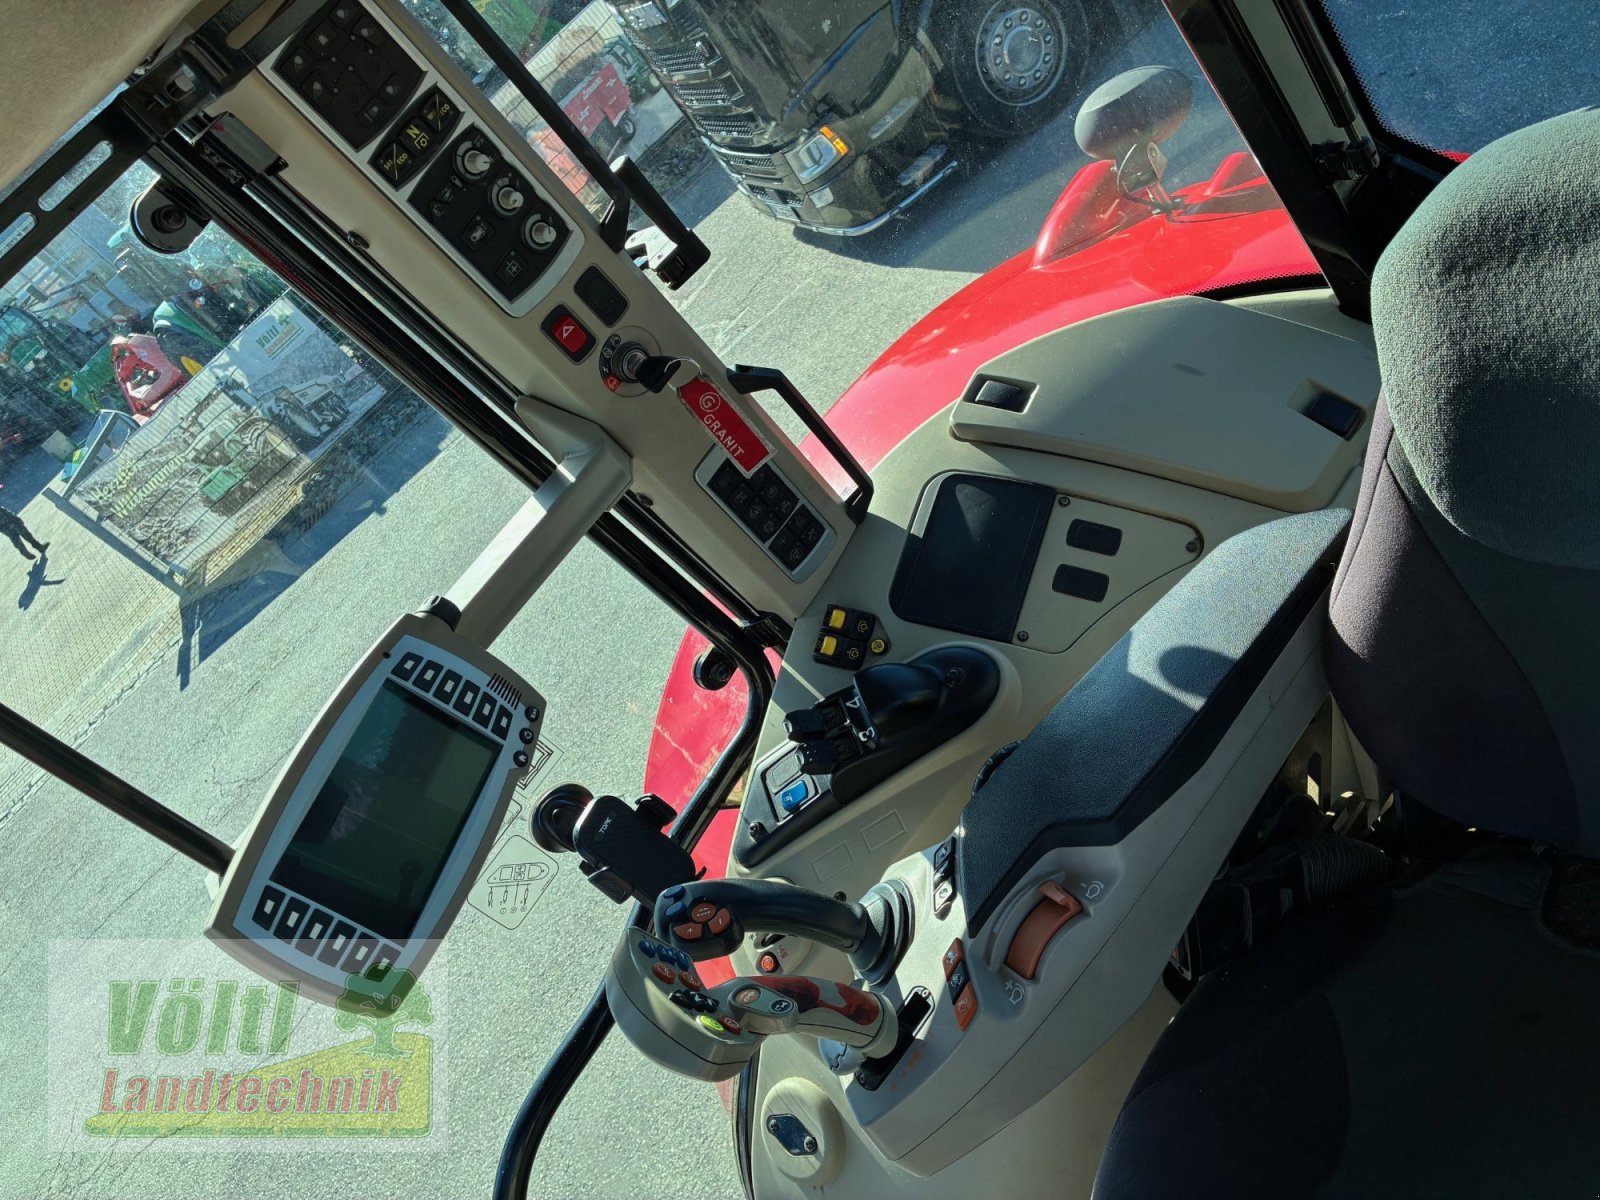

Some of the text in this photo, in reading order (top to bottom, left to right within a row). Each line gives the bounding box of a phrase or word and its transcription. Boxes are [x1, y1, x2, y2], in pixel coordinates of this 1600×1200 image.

[406, 124, 420, 138] N
[396, 152, 408, 165] ECO
[703, 413, 745, 457] GRANIT
[109, 454, 186, 519] Willkommen
